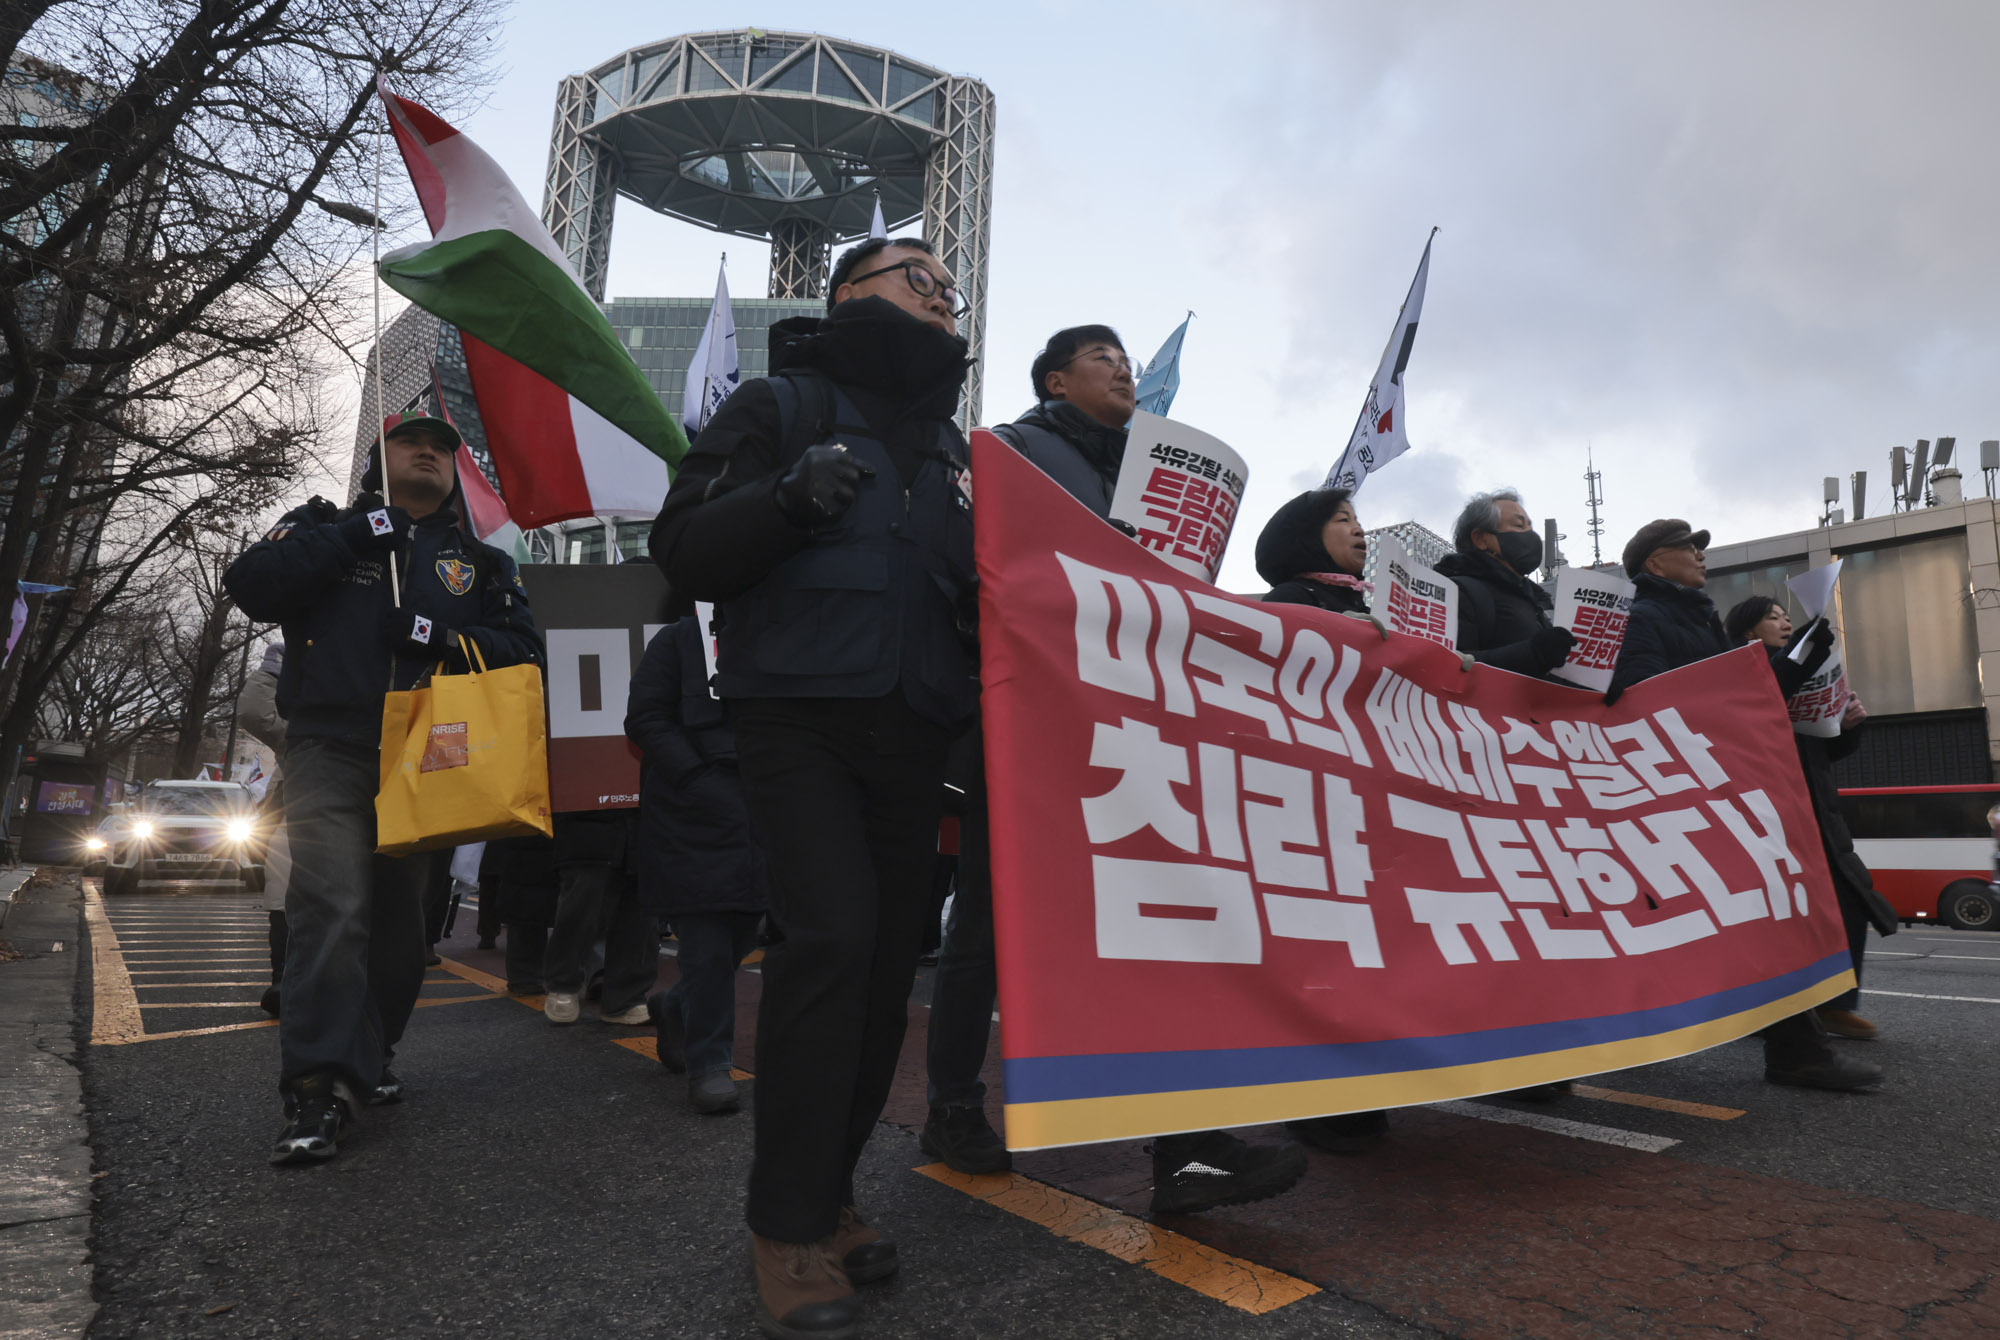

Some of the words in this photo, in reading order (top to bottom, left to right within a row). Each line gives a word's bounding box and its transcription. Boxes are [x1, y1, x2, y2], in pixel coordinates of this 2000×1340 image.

[1149, 443, 1222, 481] 석유강탈
[352, 576, 372, 586] 1943
[355, 568, 381, 581] CHINA
[1410, 577, 1446, 603] 식민지배
[1574, 588, 1618, 608] 석유강탈
[1387, 581, 1447, 636] 트럼프를
[1055, 551, 1374, 768] 미국의
[1366, 667, 1732, 811] 베네수엘라
[431, 724, 466, 735] NRISE
[1081, 715, 1385, 969] 침략
[1386, 788, 1809, 967] 규탄한다!
